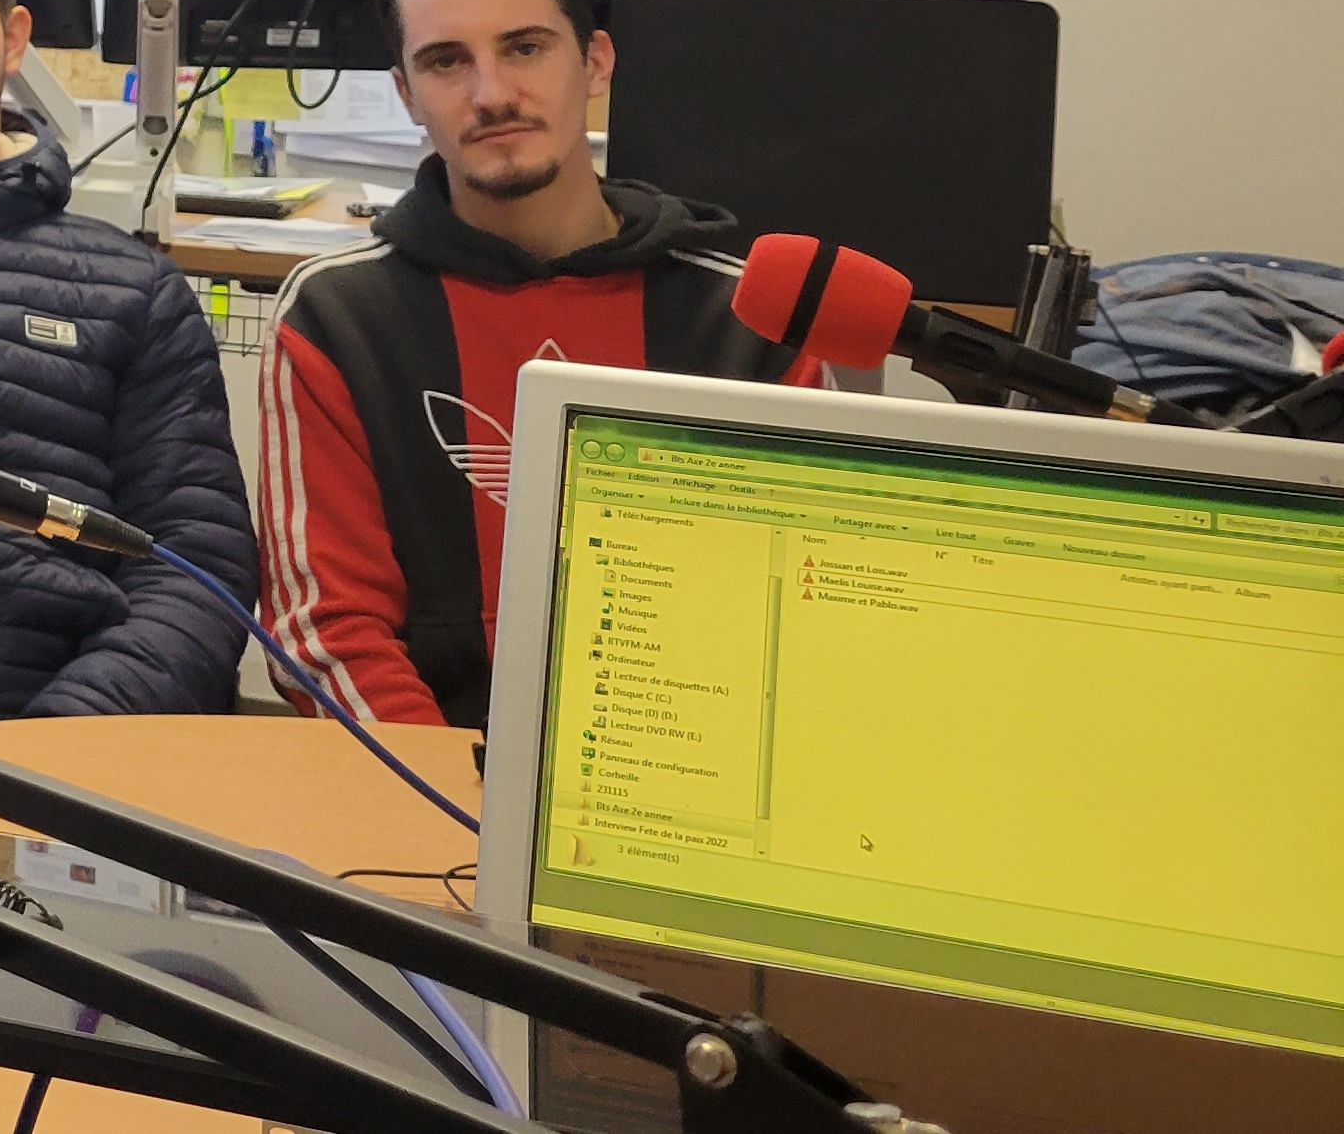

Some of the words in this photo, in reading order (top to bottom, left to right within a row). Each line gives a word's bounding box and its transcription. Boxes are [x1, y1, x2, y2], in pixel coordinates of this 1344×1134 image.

[672, 477, 716, 491] Affichage
[729, 484, 756, 495] Outils
[591, 486, 633, 500] Organiser
[669, 496, 701, 508] Inclure
[703, 500, 725, 511] dans
[727, 502, 735, 512] la
[737, 503, 795, 520] bibliothèque
[833, 516, 873, 529] Partager
[875, 521, 896, 531] avec
[936, 528, 954, 539] Lire
[955, 531, 976, 541] tout
[1003, 537, 1035, 548] Graver
[1063, 543, 1108, 557] Nouveau
[1111, 549, 1145, 561] dossier
[616, 509, 694, 527] Téléchargements
[606, 540, 638, 552] Bureau
[613, 557, 675, 574] Bibliothèques
[803, 534, 827, 545] Nom
[972, 555, 995, 566] Titre
[1120, 573, 1158, 585] Artistes
[1160, 579, 1188, 591] ayant
[1235, 587, 1271, 599] Album
[855, 563, 864, 572] et
[866, 564, 908, 578] Lois.wav
[620, 574, 672, 589] Documents
[819, 575, 850, 588] Maelis
[852, 579, 905, 595] Louise.wav
[619, 590, 652, 603] Images
[818, 592, 857, 605] Maxime
[858, 597, 868, 606] et
[869, 598, 919, 613] Pablo.wav
[618, 606, 658, 620] Musique
[617, 621, 647, 634] Vidéos
[608, 637, 661, 652] RTVFM-AM
[606, 653, 655, 668] Ordinateur
[613, 671, 647, 684] Lecteur
[649, 676, 661, 685] de
[663, 677, 711, 693] disquettes
[712, 685, 729, 696] (A:)
[612, 687, 644, 700] Disque
[646, 692, 653, 701] C
[655, 693, 672, 704] (C:)
[612, 703, 643, 717] Disque
[645, 708, 659, 720] (D)
[661, 711, 677, 722] (D:)
[610, 720, 644, 732] Lecteur
[646, 725, 666, 736] DVD
[668, 728, 685, 739] RW
[687, 731, 702, 742] (E:)
[600, 735, 632, 748] Réseau
[599, 751, 639, 766] Panneau
[641, 758, 653, 768] de
[655, 760, 718, 778] configuration
[598, 768, 639, 782] Corbeille
[596, 784, 629, 797] 231115
[596, 801, 611, 812] Bts
[613, 804, 630, 815] Axe
[631, 807, 643, 816] 2e
[644, 811, 673, 822] annee
[594, 818, 637, 833] Interview
[639, 826, 659, 838] Fete
[661, 829, 673, 839] de
[675, 831, 683, 841] la
[706, 837, 728, 848] 2022
[617, 844, 624, 853] 3
[627, 846, 679, 864] élément(s)
